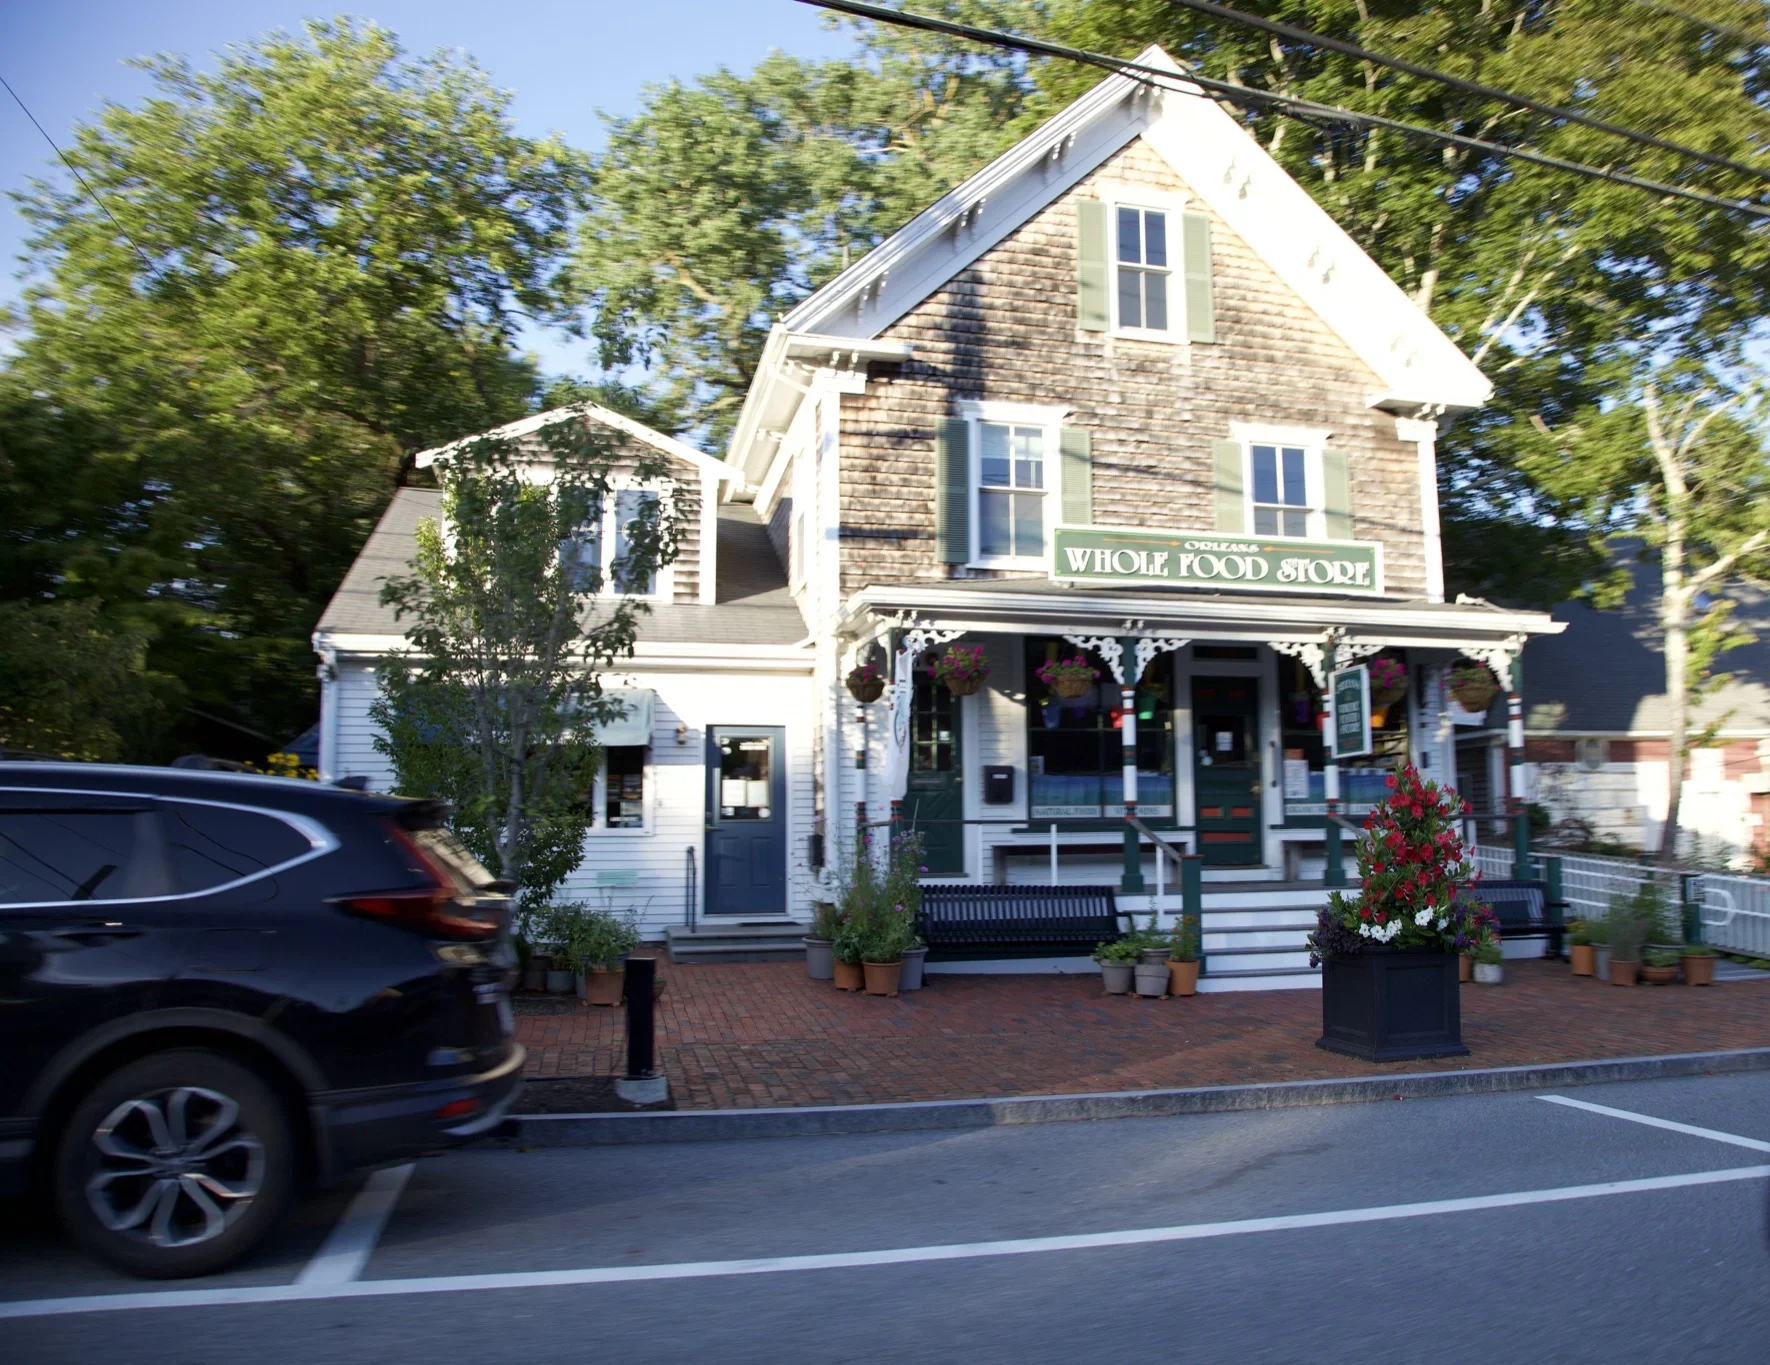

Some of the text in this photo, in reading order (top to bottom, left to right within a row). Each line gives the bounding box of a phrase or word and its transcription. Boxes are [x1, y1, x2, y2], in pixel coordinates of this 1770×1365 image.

[1184, 540, 1260, 553] ORLEANS
[1063, 547, 1371, 587] WHOLE FOOD STORE
